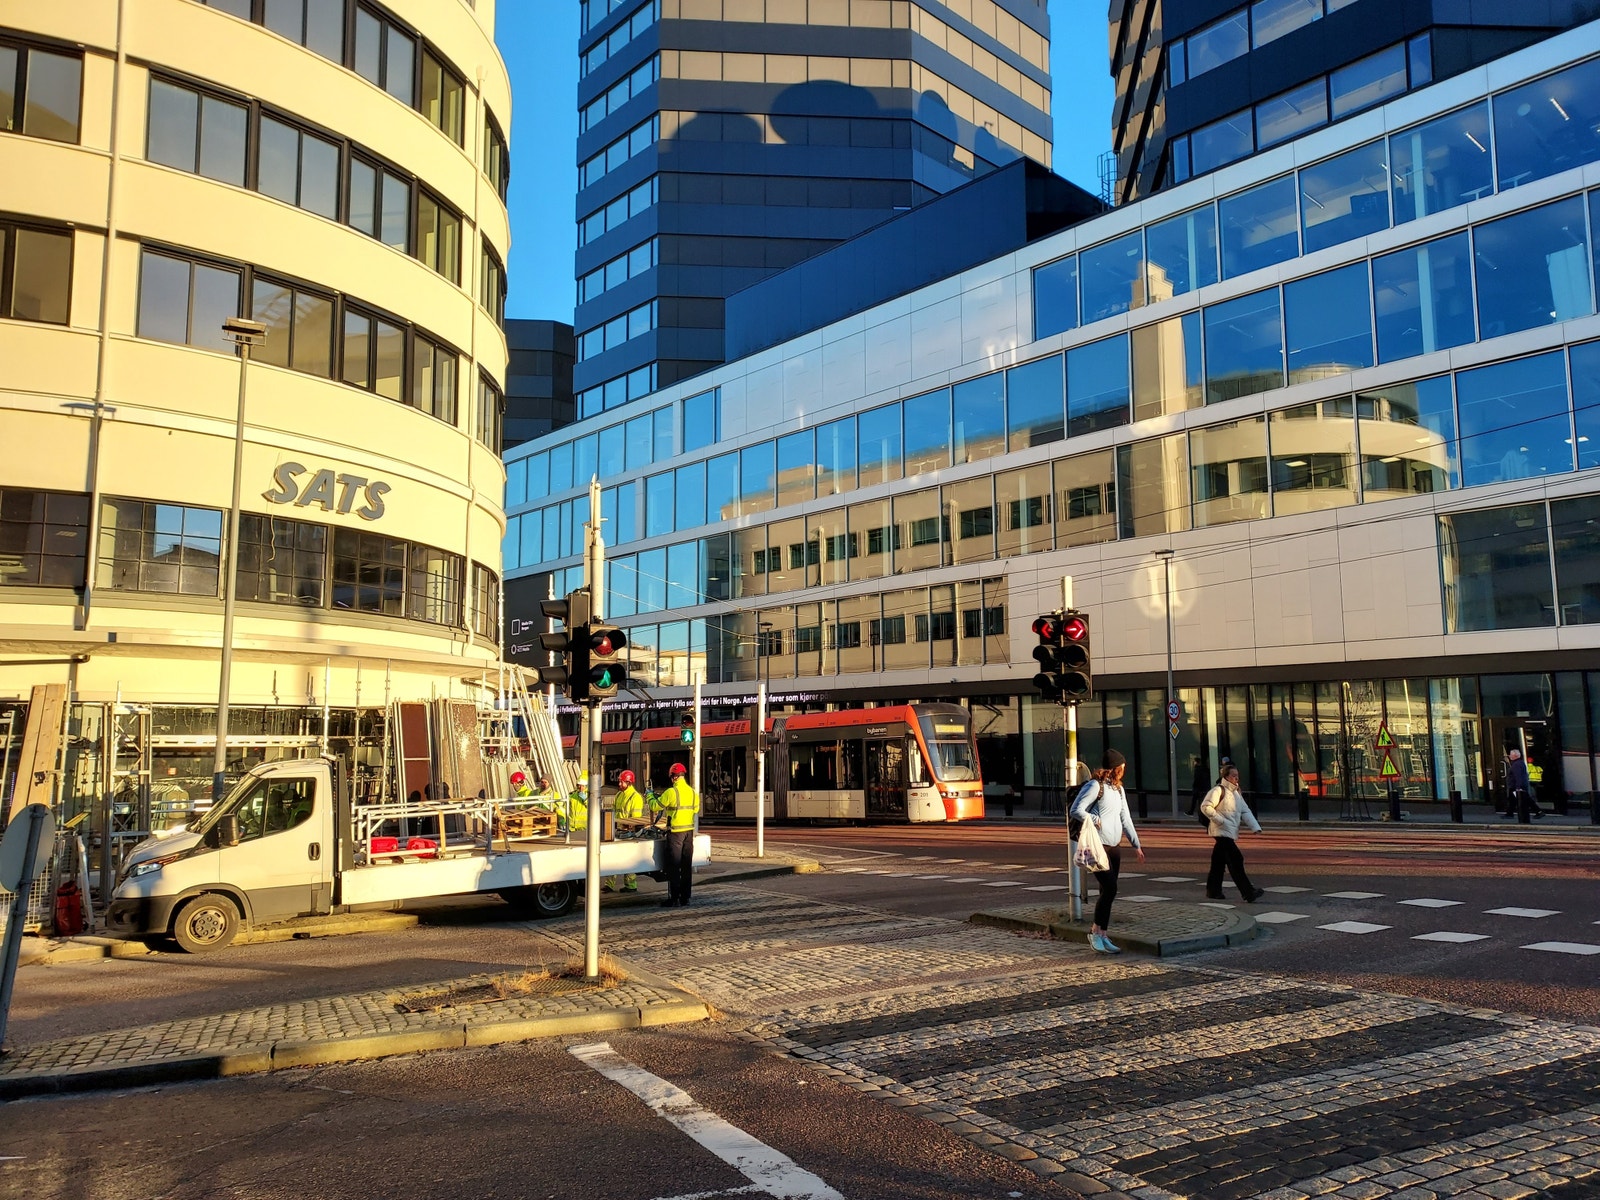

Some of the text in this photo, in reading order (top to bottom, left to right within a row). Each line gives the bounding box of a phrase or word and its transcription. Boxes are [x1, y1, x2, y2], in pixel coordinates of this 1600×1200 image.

[261, 461, 391, 521] SATS
[723, 697, 741, 705] Norge.
[800, 692, 818, 702] kjører
[1169, 704, 1178, 716] 30
